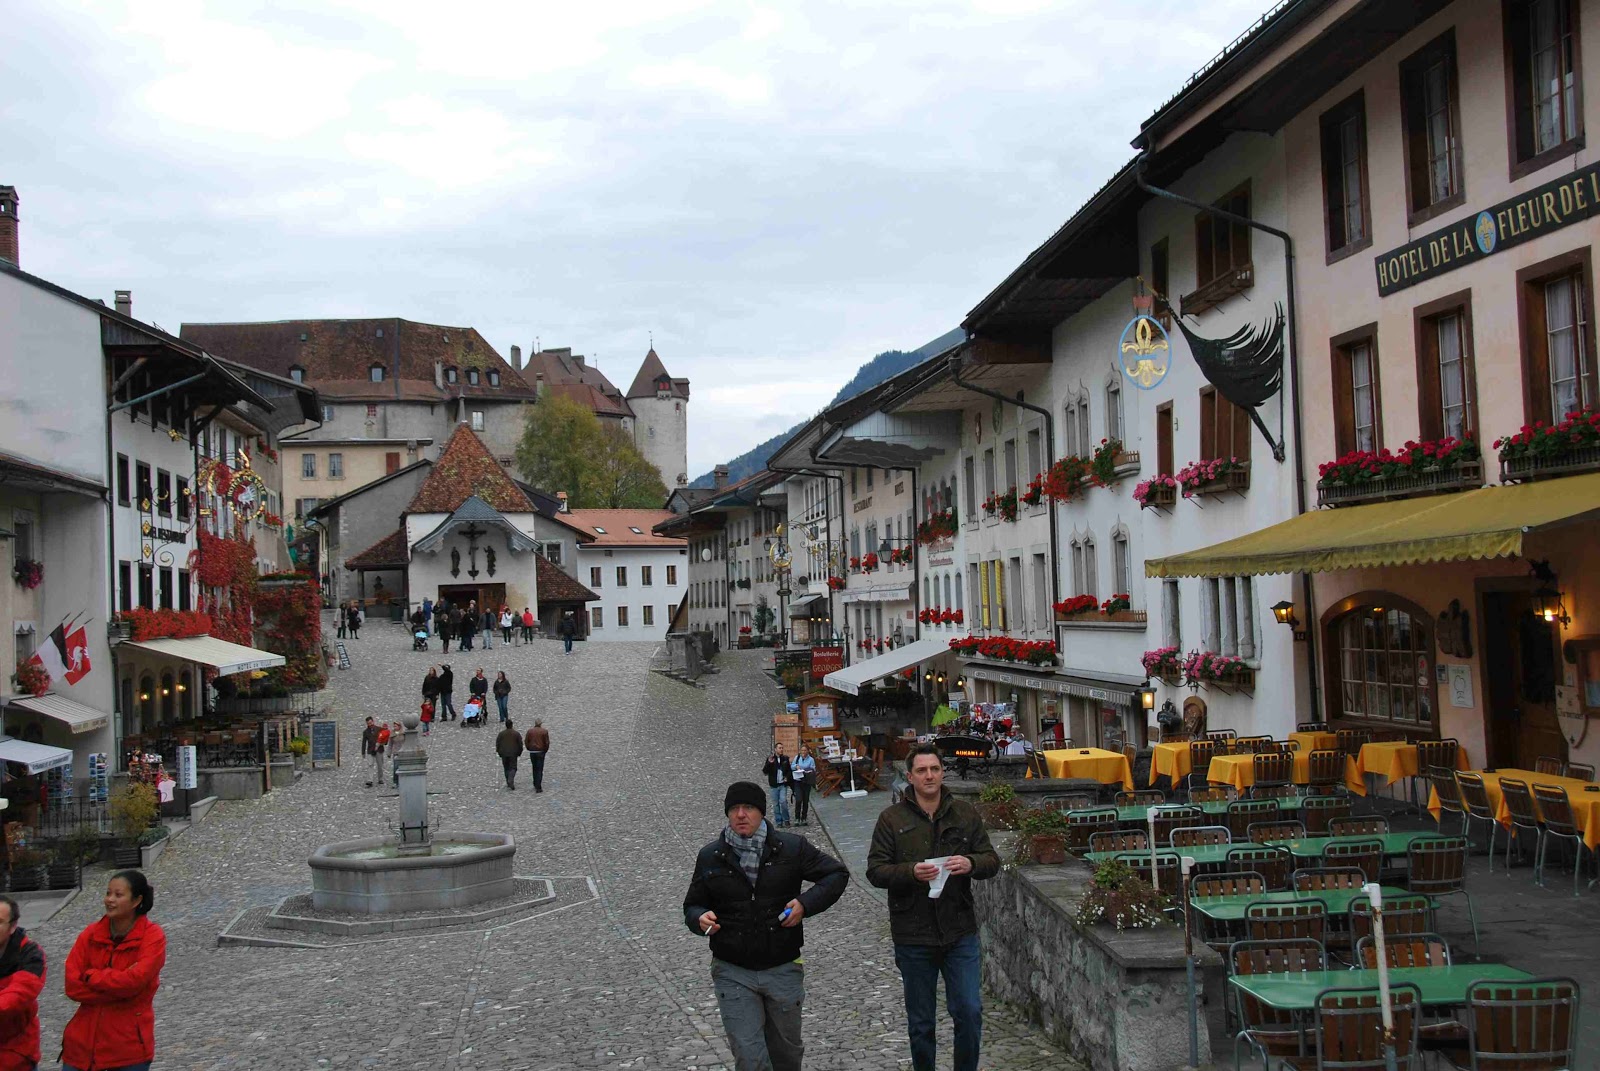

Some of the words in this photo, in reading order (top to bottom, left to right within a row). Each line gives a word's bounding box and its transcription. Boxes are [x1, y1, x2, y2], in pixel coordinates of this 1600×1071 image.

[1378, 247, 1428, 288] HOTEL
[1430, 235, 1451, 267] DE
[1452, 227, 1475, 258] LA
[1497, 192, 1562, 241] FLEUR
[1559, 178, 1587, 216] DE
